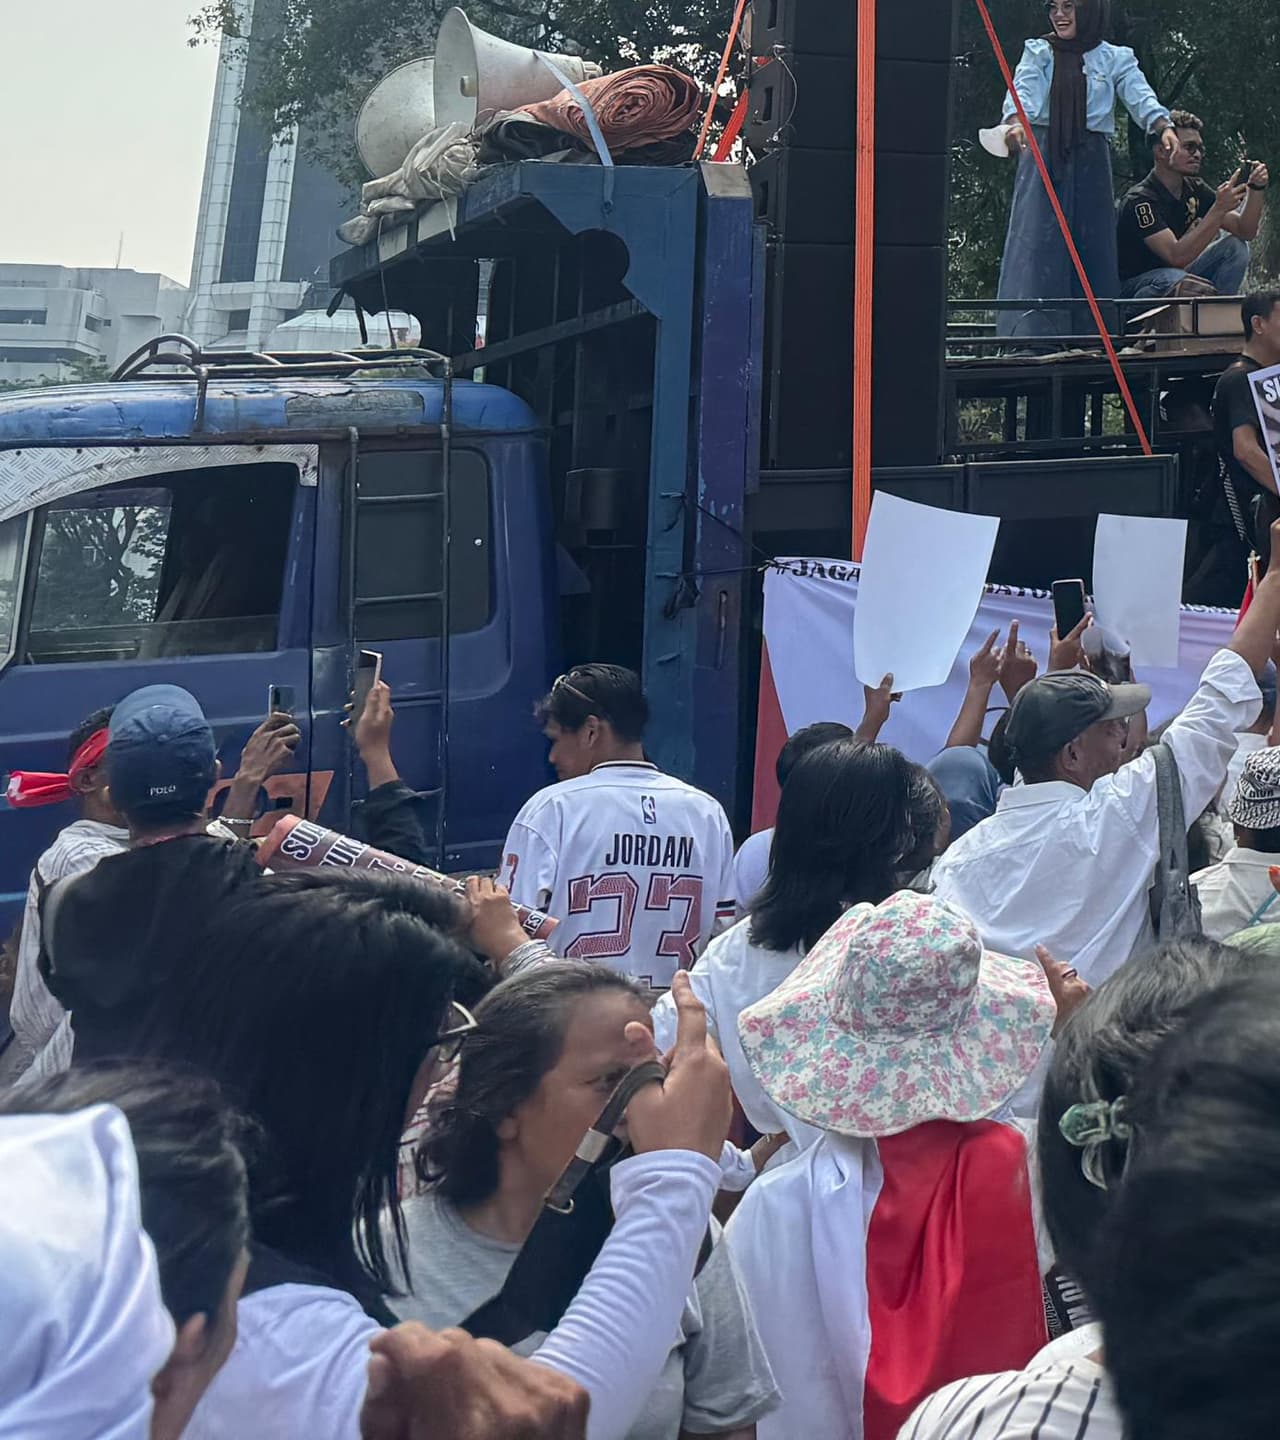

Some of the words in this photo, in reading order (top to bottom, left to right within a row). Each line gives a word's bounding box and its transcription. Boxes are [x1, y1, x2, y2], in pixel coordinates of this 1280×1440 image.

[1135, 202, 1155, 229] 8
[605, 833, 695, 868] JORDAN
[563, 871, 705, 990] 23
